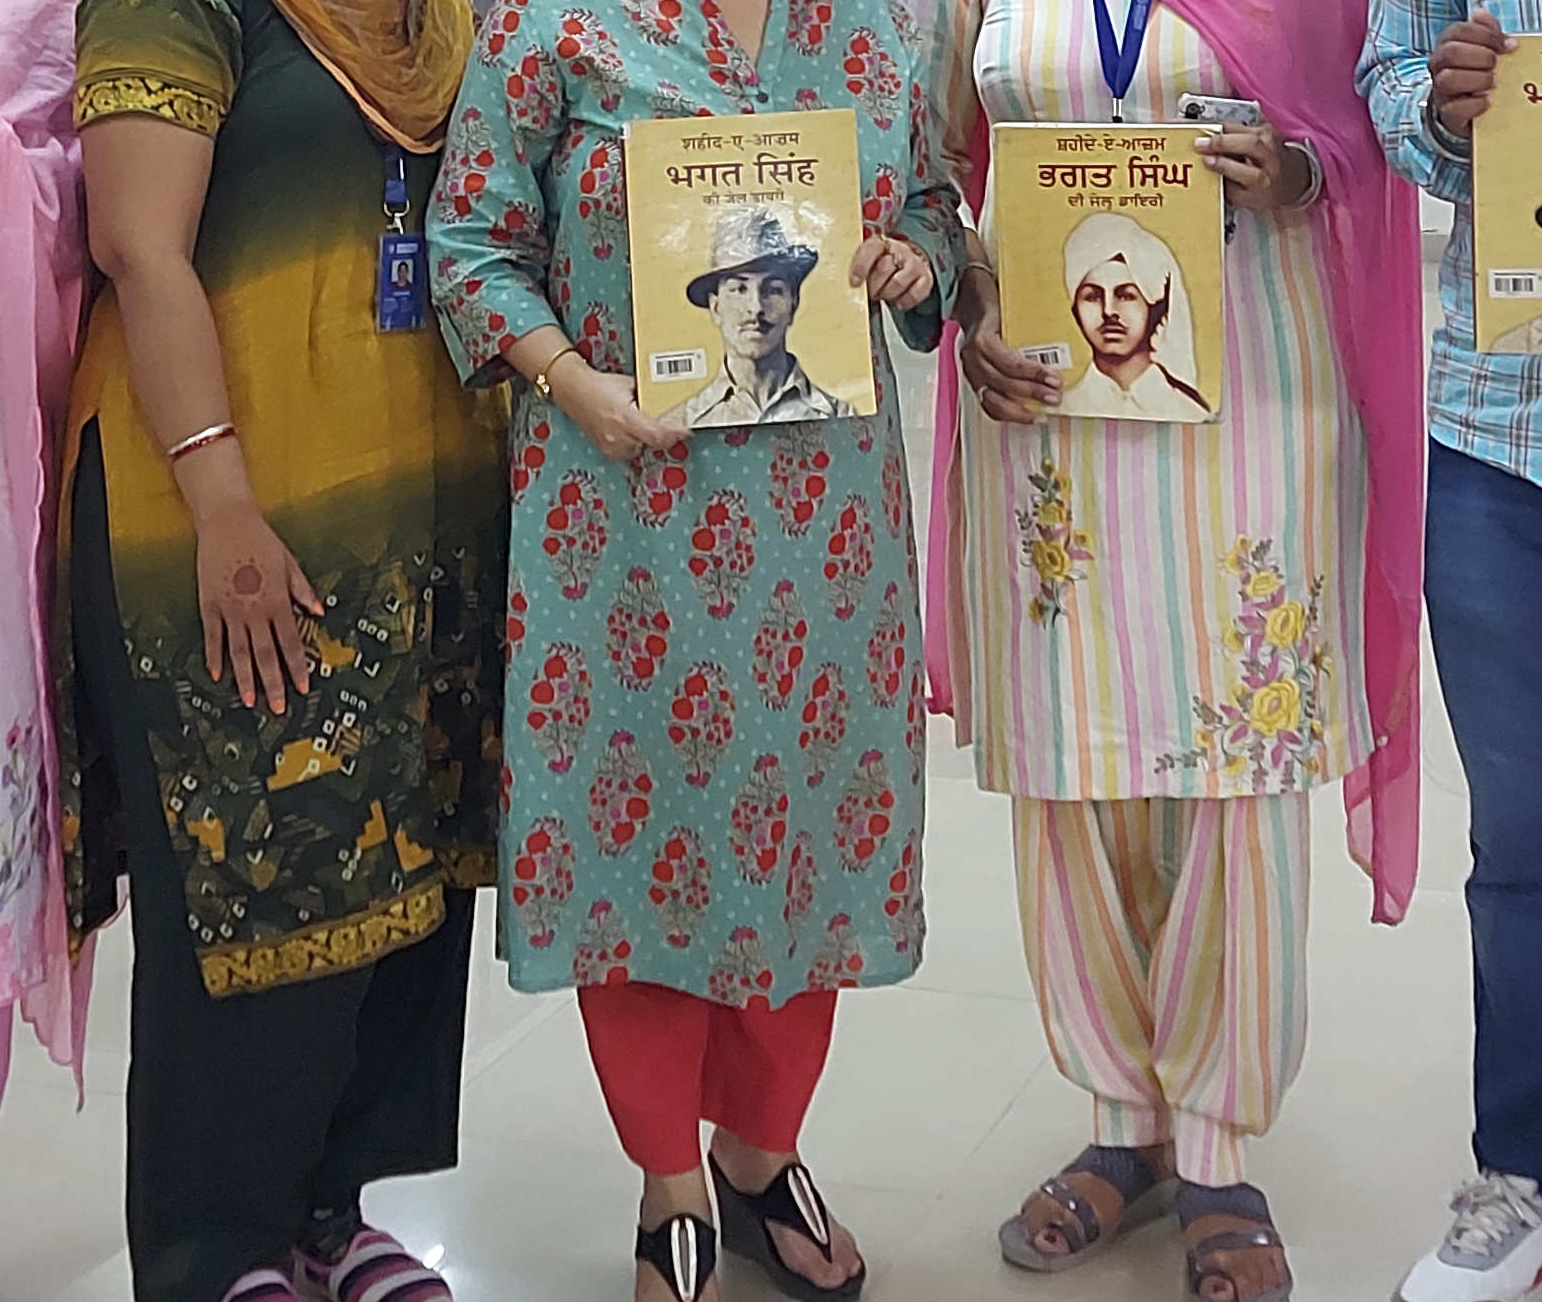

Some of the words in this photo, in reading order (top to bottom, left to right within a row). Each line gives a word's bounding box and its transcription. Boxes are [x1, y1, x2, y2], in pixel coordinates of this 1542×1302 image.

[666, 163, 744, 188] भगत
[752, 152, 819, 186] सिंह
[1038, 164, 1117, 188] ਭਗਤ
[1128, 154, 1193, 188] ਸਿੰਘ
[1068, 193, 1084, 207] ਦੀ
